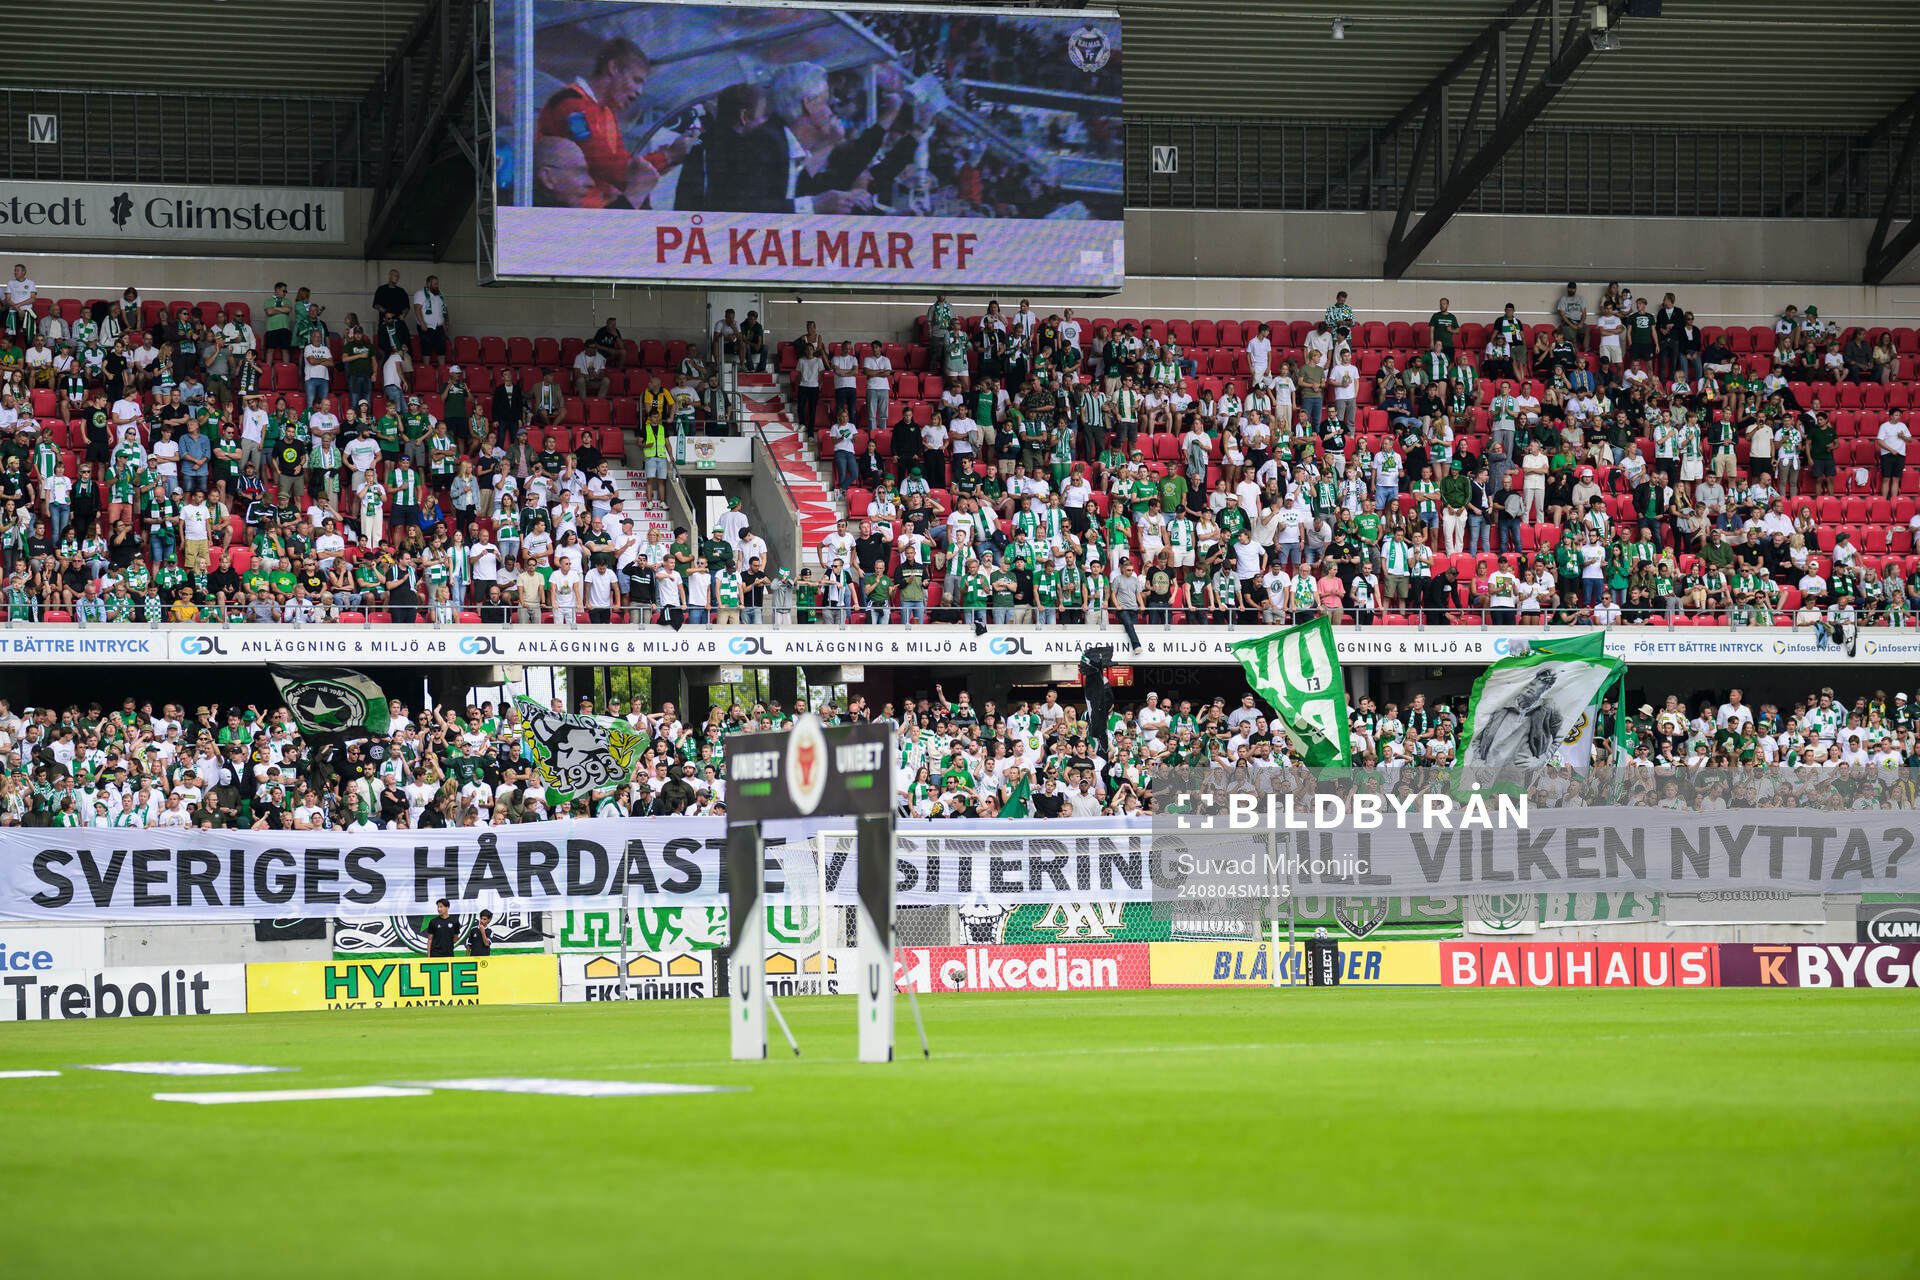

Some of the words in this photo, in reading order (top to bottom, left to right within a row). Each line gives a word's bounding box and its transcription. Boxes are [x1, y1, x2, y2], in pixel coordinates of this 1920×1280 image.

[30, 115, 56, 142] M
[1154, 147, 1177, 171] M
[144, 197, 327, 232] Glimstedt
[656, 214, 712, 265] PÅ
[728, 228, 912, 269] KALMAR
[932, 232, 978, 270] FF
[644, 511, 663, 519] MAXI
[14, 636, 74, 653] BÄTTRE
[80, 640, 149, 652] INTRYCK
[242, 638, 347, 652] ANLÄGGNING
[354, 641, 363, 652] &
[372, 639, 418, 652] MILJÖ
[427, 641, 446, 652] AB
[518, 639, 620, 652] ANLÄGGNING
[627, 642, 635, 652] &
[643, 640, 689, 652] MILJÖ
[698, 642, 716, 652] AB
[785, 639, 883, 652] ANLÄGGNING
[891, 642, 899, 652] &
[907, 639, 951, 652] MILJÖ
[959, 642, 977, 652] AB
[1148, 642, 1156, 652] &
[1164, 640, 1206, 652] MILJÖ
[1215, 642, 1231, 652] AB
[1337, 643, 1392, 653] GGNING
[1400, 643, 1407, 652] &
[1415, 640, 1457, 652] MILJÖ
[1464, 643, 1482, 652] AB
[1634, 639, 1655, 652] FÖR
[1658, 643, 1676, 652] ETT
[1679, 640, 1716, 652] BÄTTRE
[1720, 643, 1763, 653] INTRYCK
[557, 755, 629, 793] 1993
[31, 846, 386, 909] SVERIGES
[807, 834, 1189, 894] VSITERING
[1410, 826, 1647, 883] VILKEN
[1670, 826, 1917, 880] NYTTA?
[325, 961, 479, 999] HYLTE
[1322, 948, 1333, 985] SELECT
[1452, 951, 1707, 986] BAUHAUS
[1797, 946, 1920, 987] BYG
[4, 968, 210, 1020] Trebolit
